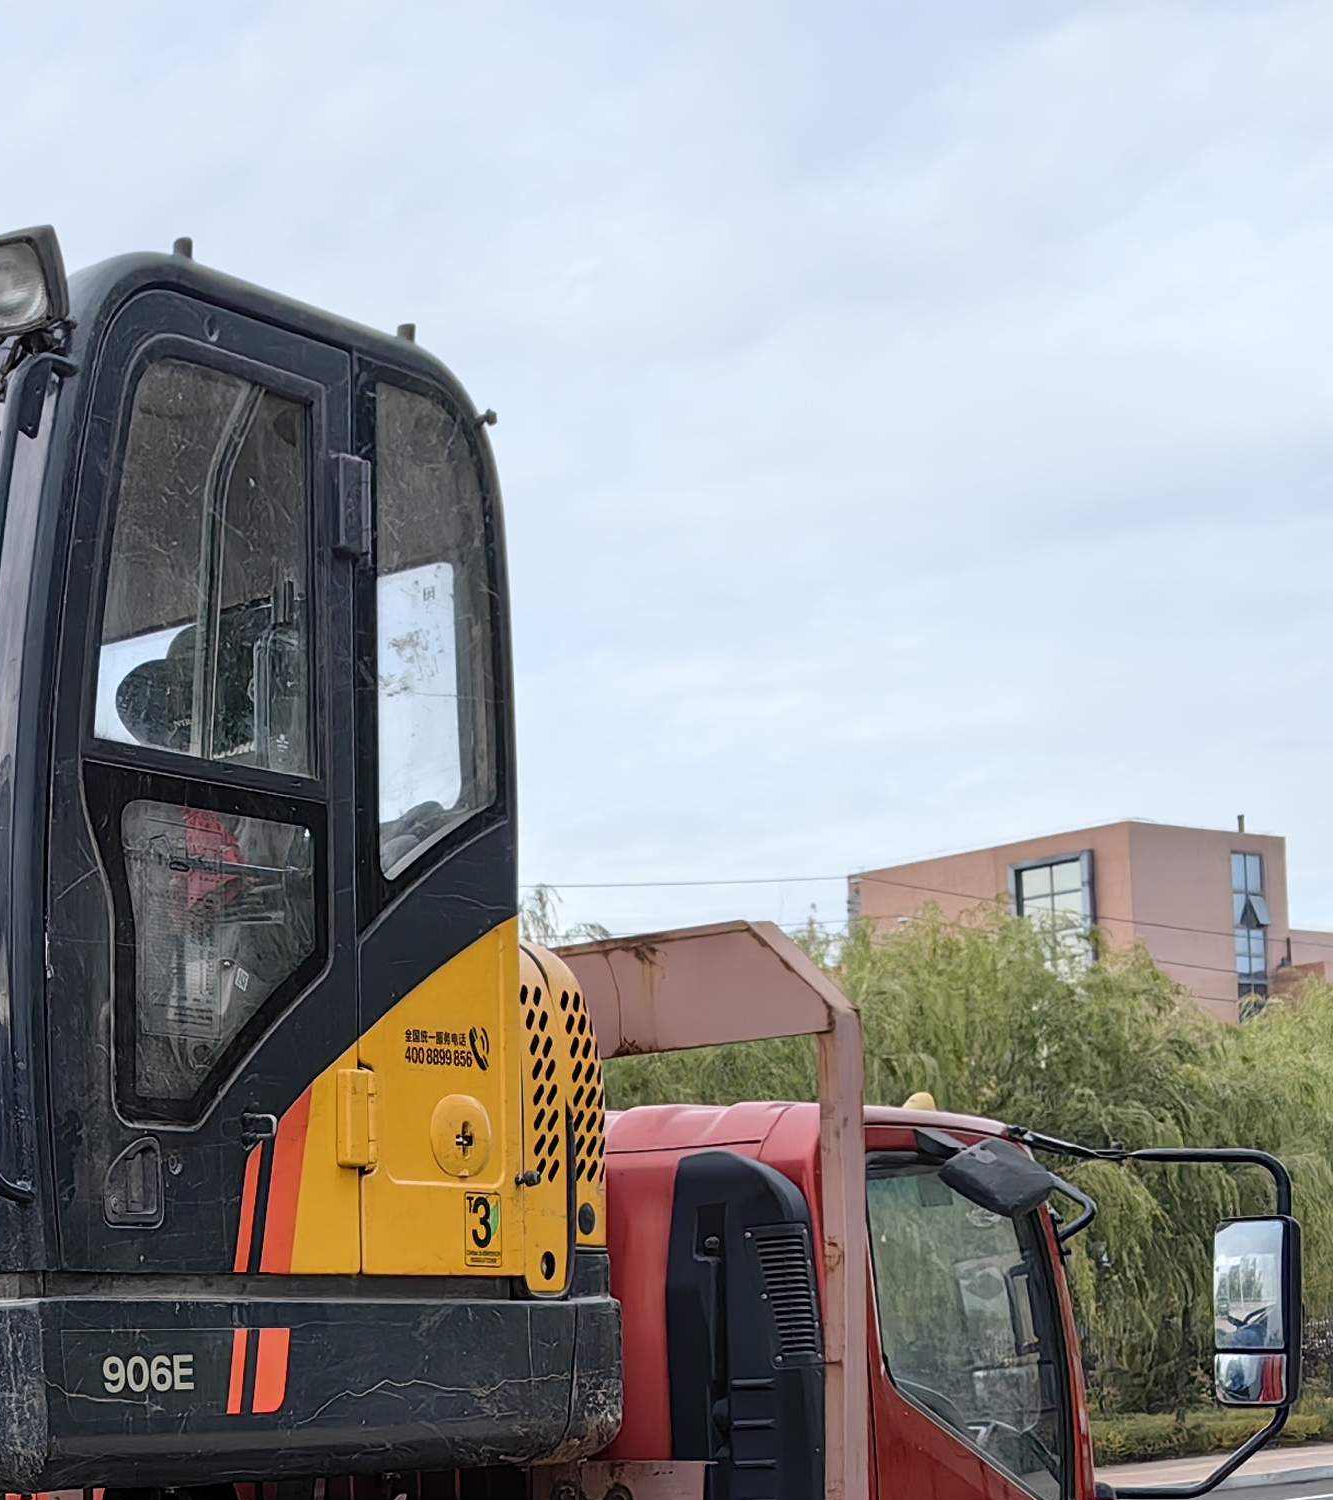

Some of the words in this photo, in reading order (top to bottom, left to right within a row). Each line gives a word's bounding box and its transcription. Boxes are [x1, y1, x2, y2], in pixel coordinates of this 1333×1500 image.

[404, 1046, 425, 1065] 400
[426, 1047, 453, 1066] 8899
[453, 1049, 473, 1068] 856
[102, 1354, 195, 1394] 906E
